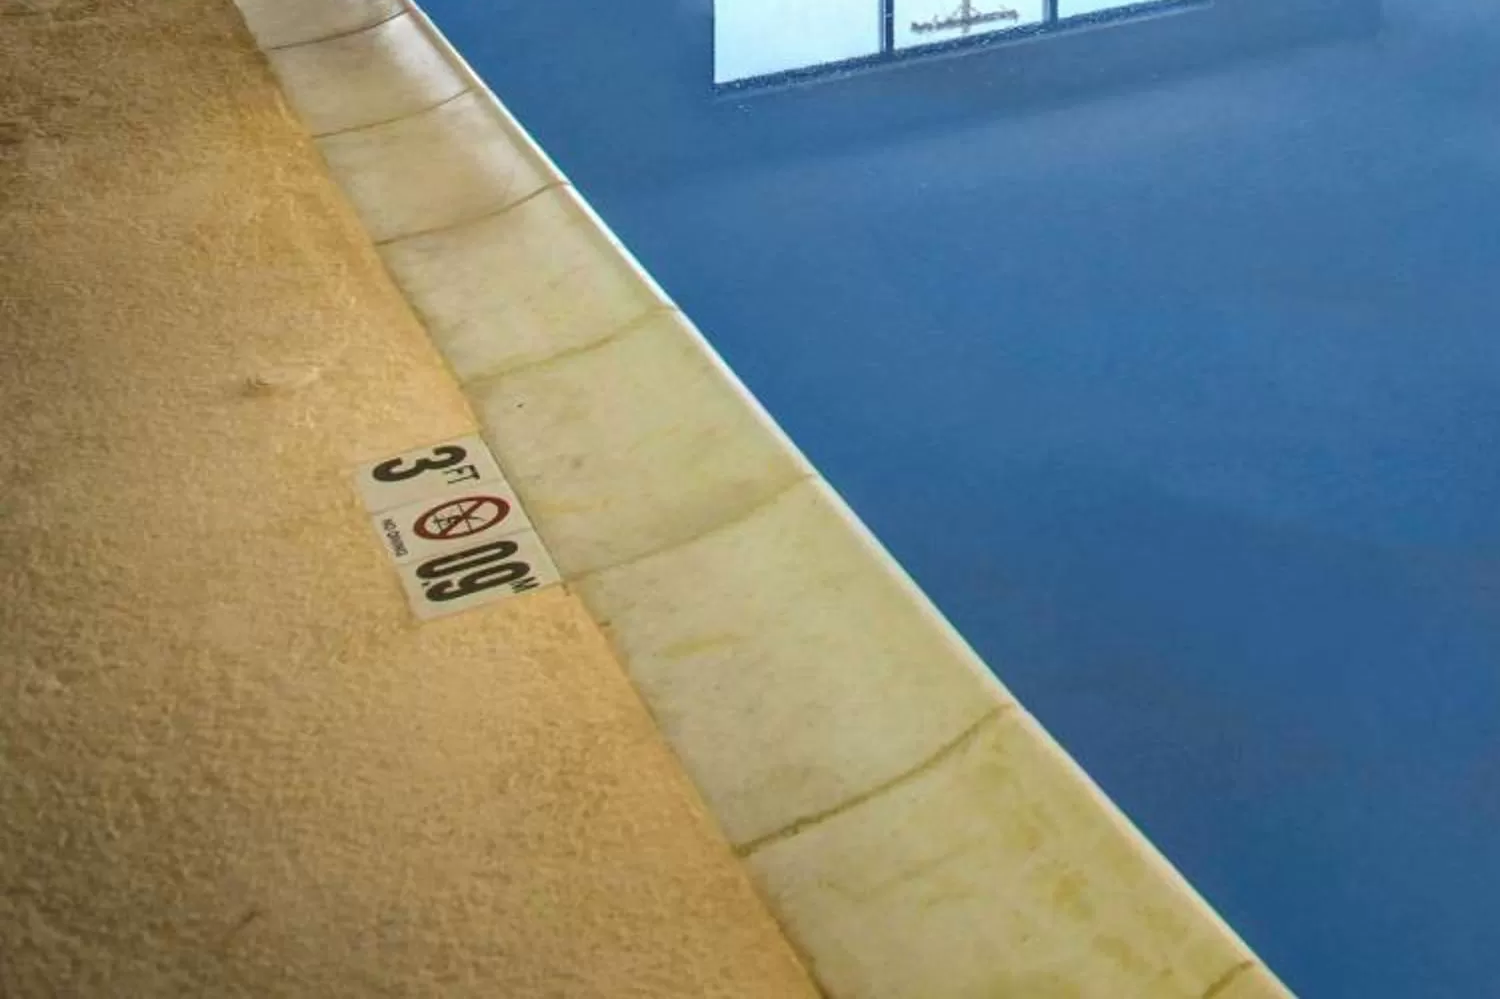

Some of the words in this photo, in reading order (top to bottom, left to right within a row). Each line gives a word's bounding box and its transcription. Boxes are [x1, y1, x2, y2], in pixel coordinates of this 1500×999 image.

[371, 444, 468, 483] 3
[442, 464, 481, 485] FT
[508, 575, 541, 595] M
